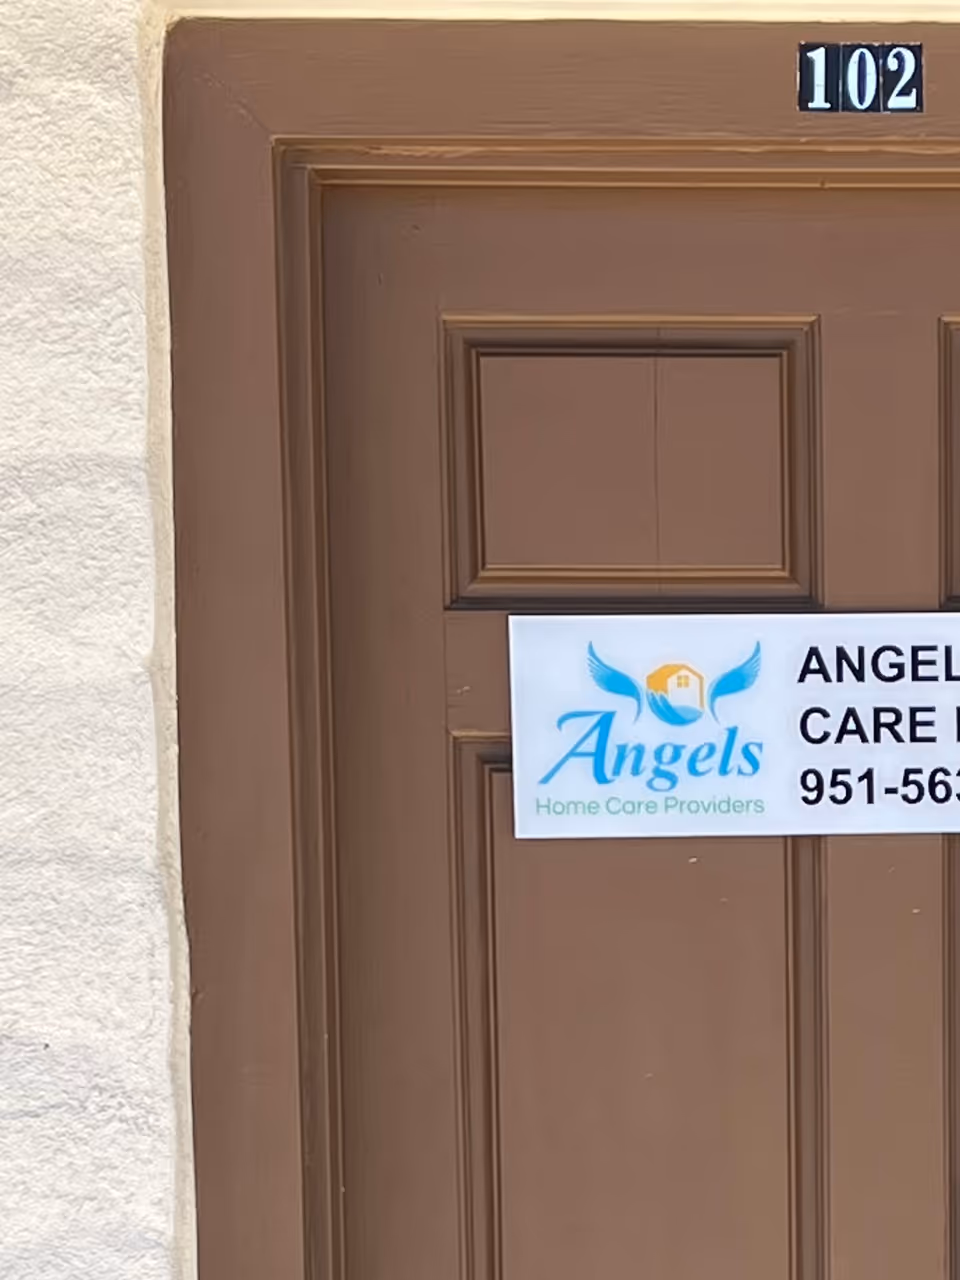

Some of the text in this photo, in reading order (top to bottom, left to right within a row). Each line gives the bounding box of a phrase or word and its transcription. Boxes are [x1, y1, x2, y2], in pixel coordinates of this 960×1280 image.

[807, 47, 916, 109] 102
[800, 706, 937, 744] CARE
[538, 710, 764, 792] Angels
[536, 797, 764, 816] Home Care Providers
